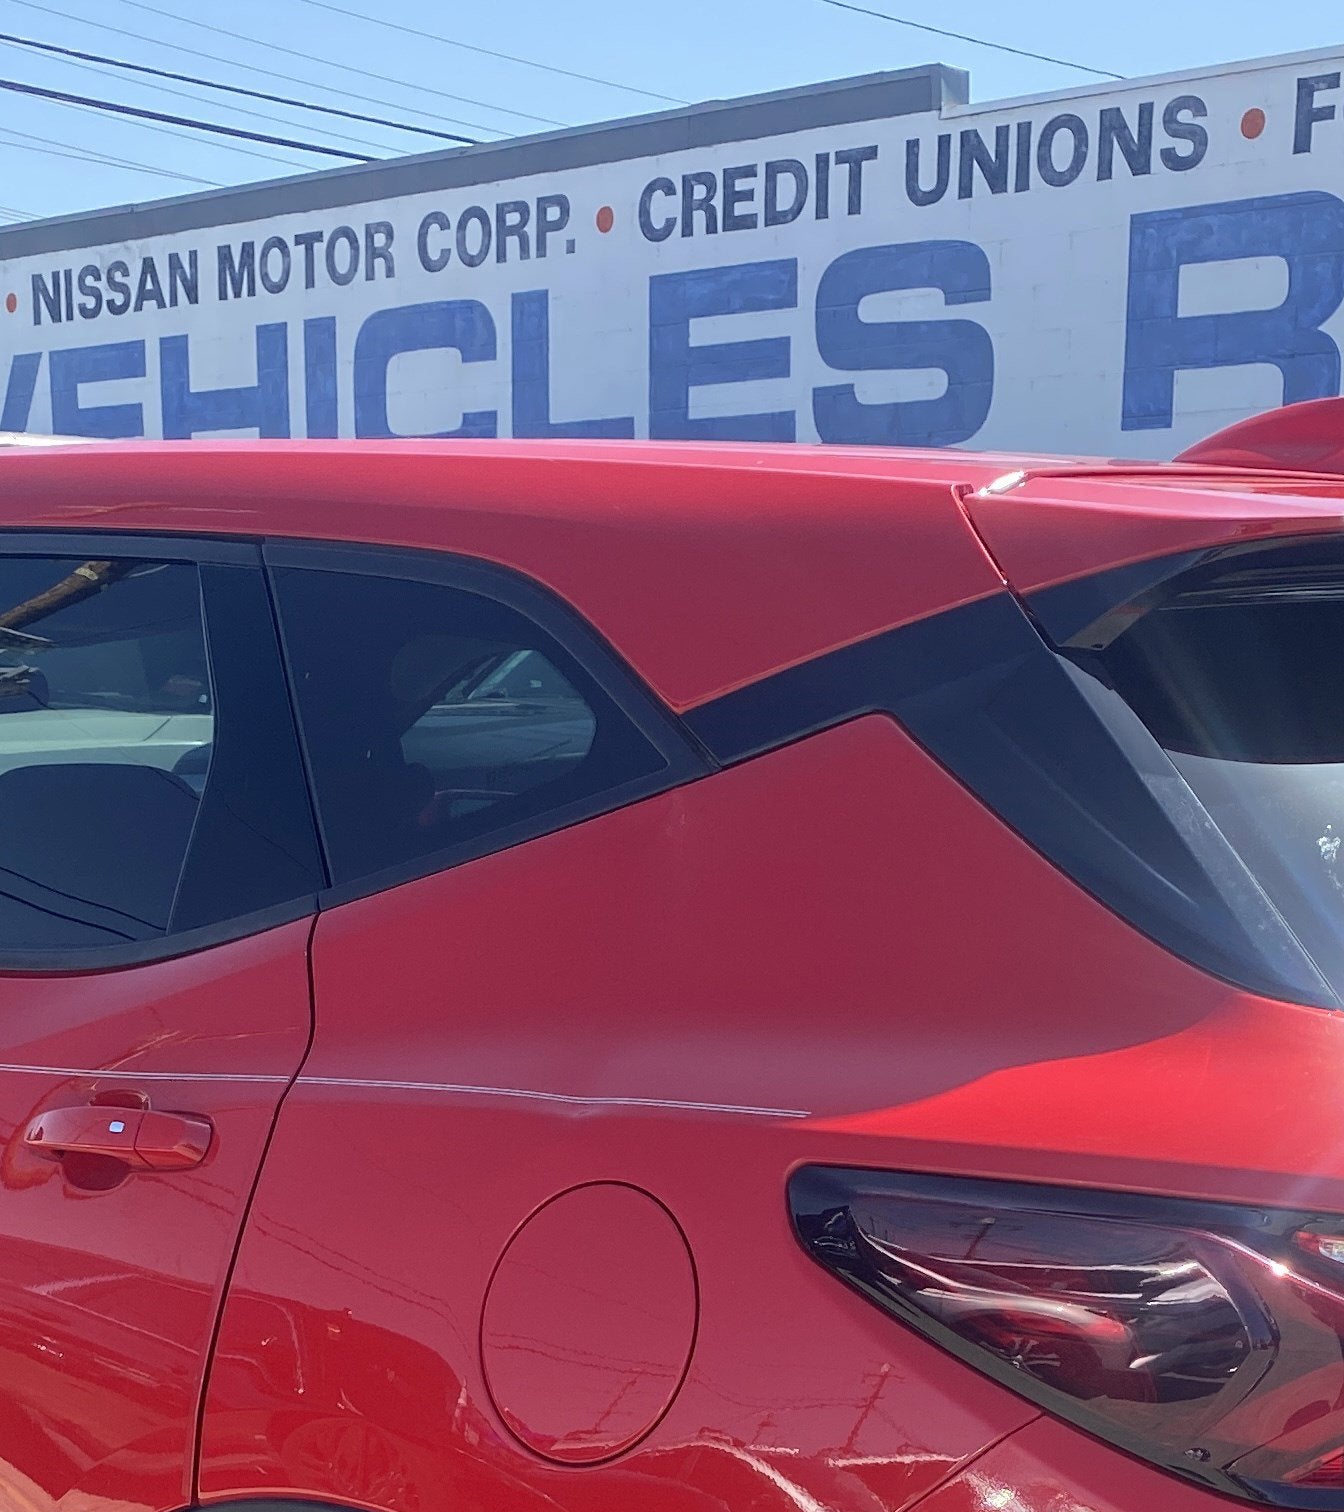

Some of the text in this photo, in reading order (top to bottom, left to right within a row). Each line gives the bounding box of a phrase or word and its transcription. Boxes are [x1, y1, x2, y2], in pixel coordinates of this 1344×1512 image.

[32, 250, 199, 326] NISSAN
[217, 220, 395, 302] MOTOR
[417, 194, 575, 272] CORP.
[638, 145, 878, 242] CREDIT
[905, 95, 1208, 207] UNIONS
